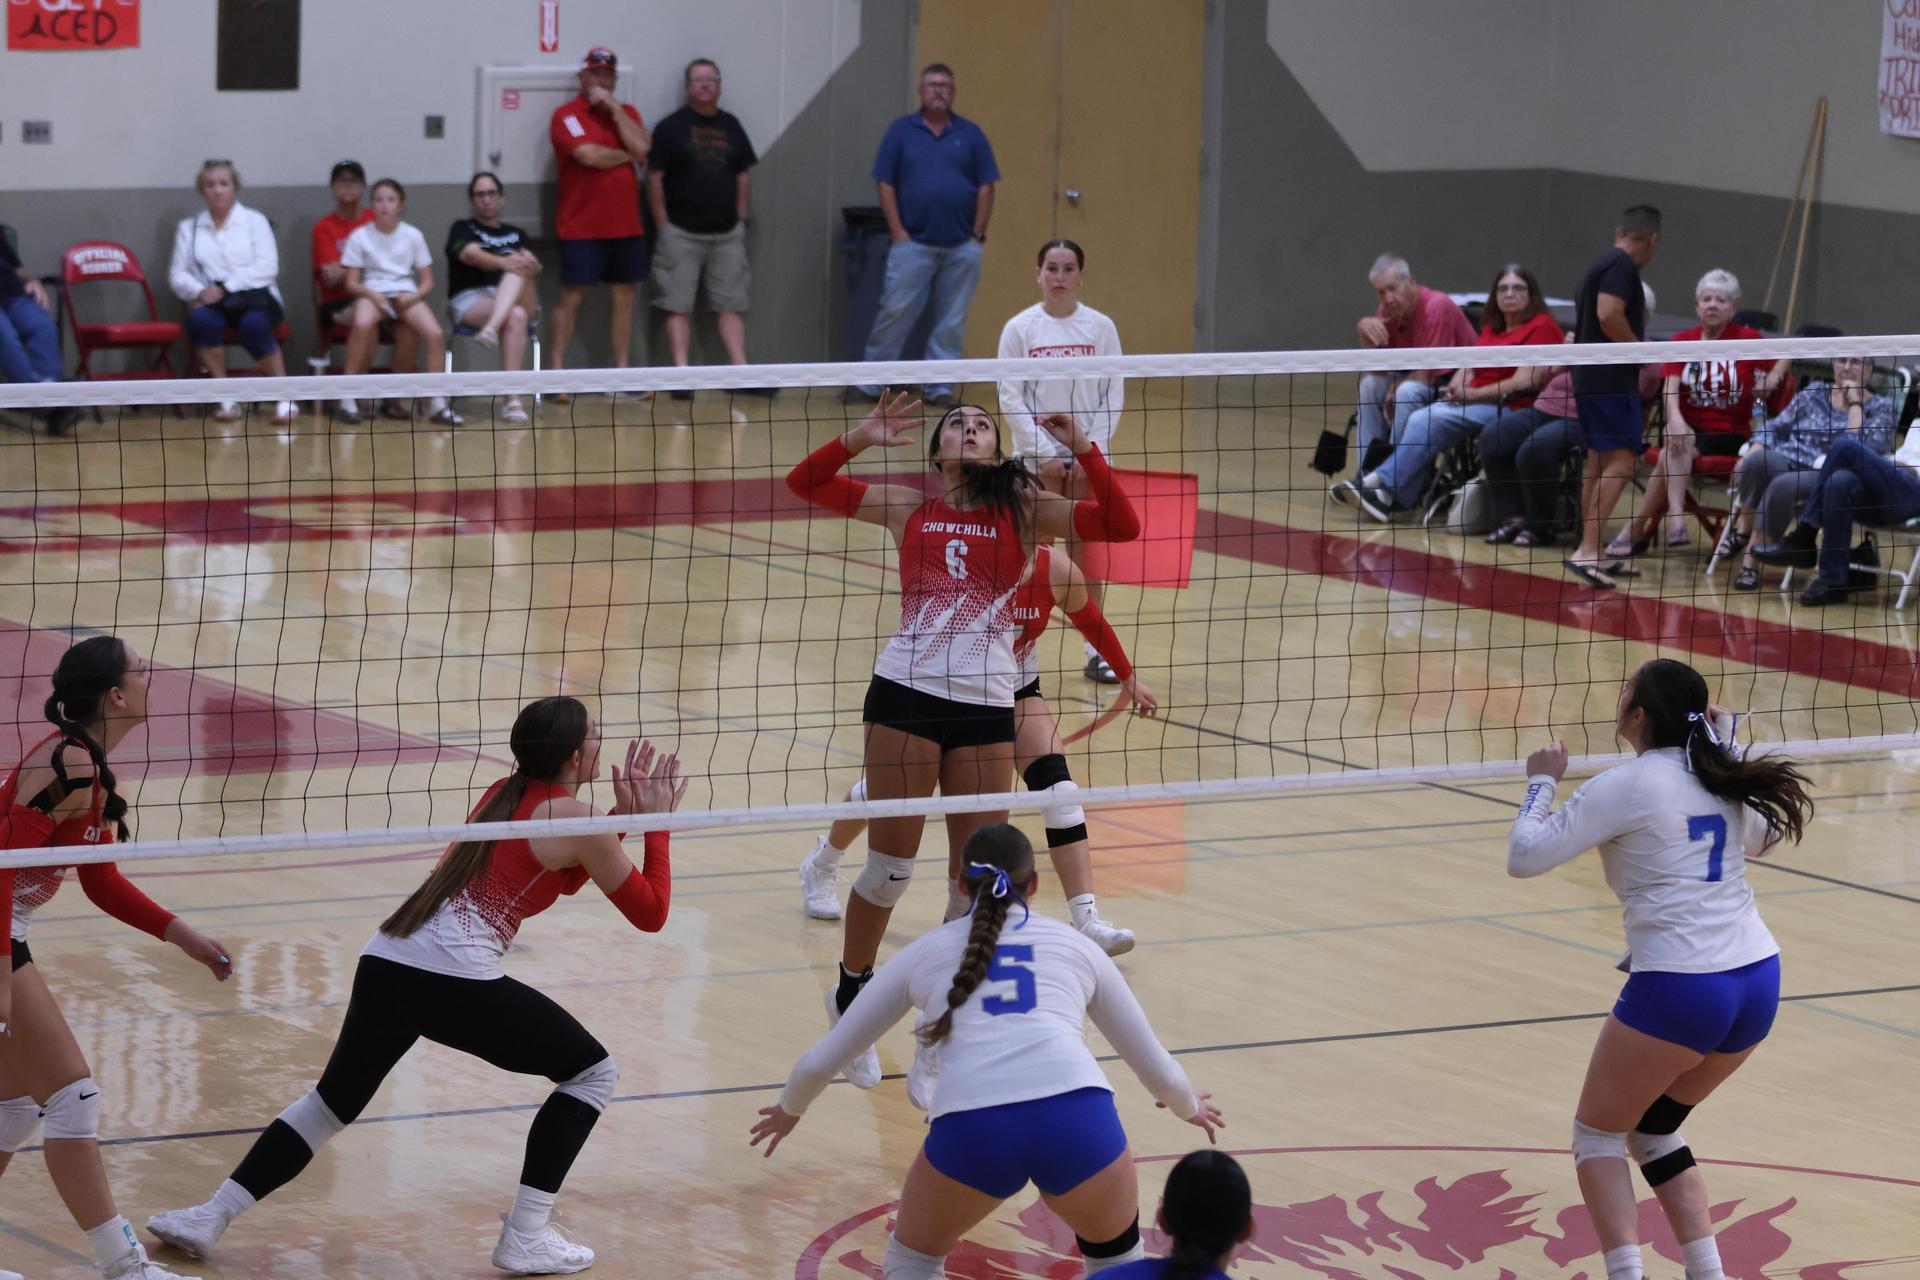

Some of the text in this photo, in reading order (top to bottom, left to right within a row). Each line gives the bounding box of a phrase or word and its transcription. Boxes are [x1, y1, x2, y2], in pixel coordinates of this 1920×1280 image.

[19, 10, 117, 46] ACED
[1886, 57, 1920, 96] TRI
[921, 522, 998, 539] CHOWCHILLA
[945, 539, 969, 581] 6
[1012, 607, 1041, 619] HILLA
[1687, 813, 1727, 882] 7
[981, 944, 1038, 1017] 5
